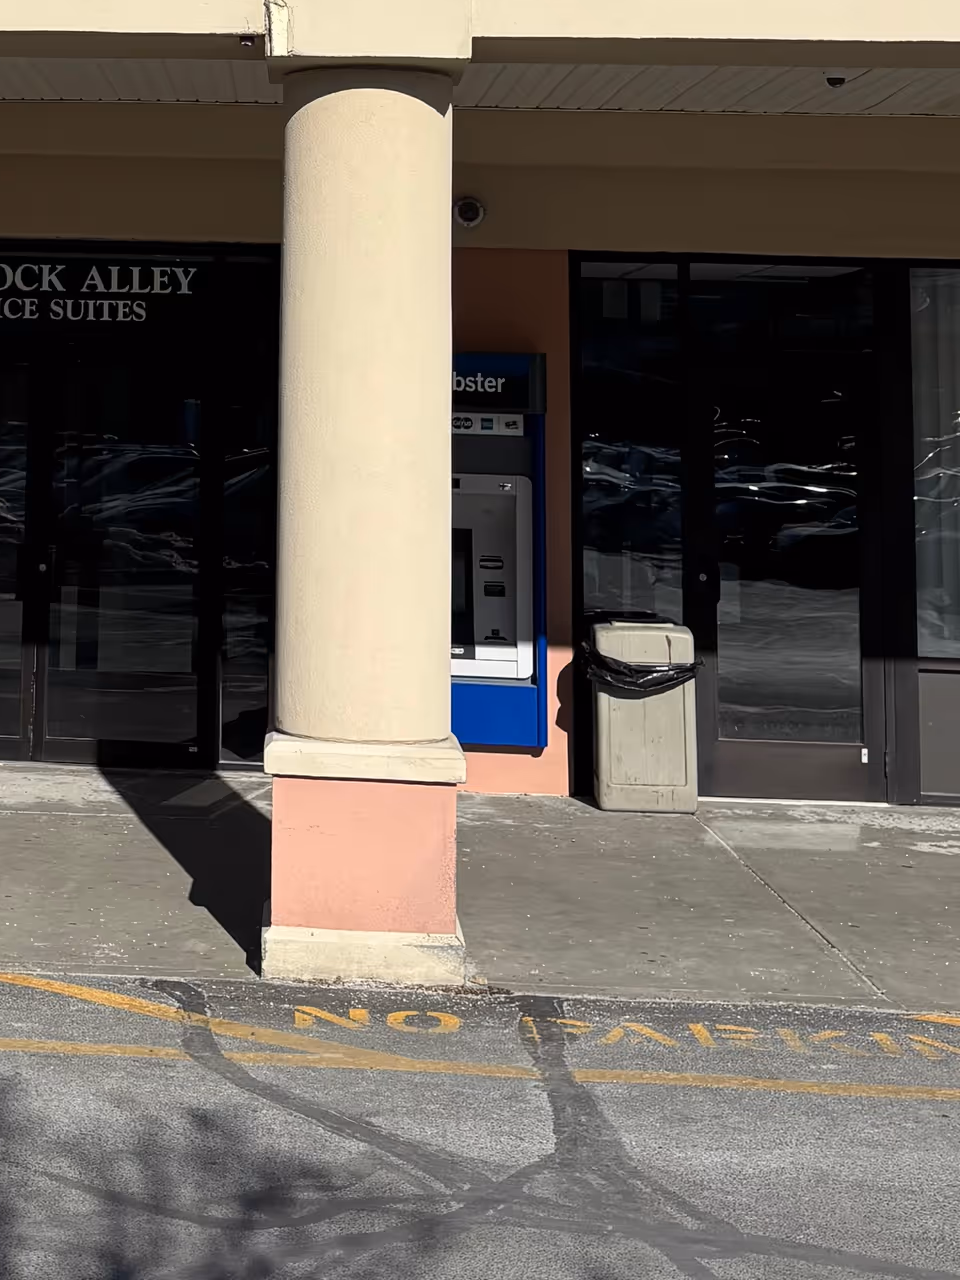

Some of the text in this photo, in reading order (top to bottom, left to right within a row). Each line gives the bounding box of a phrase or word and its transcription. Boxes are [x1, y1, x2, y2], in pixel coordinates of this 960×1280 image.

[80, 265, 197, 295] ALLEY
[49, 298, 146, 321] SUITES
[452, 371, 505, 392] bster
[294, 1005, 462, 1035] NO
